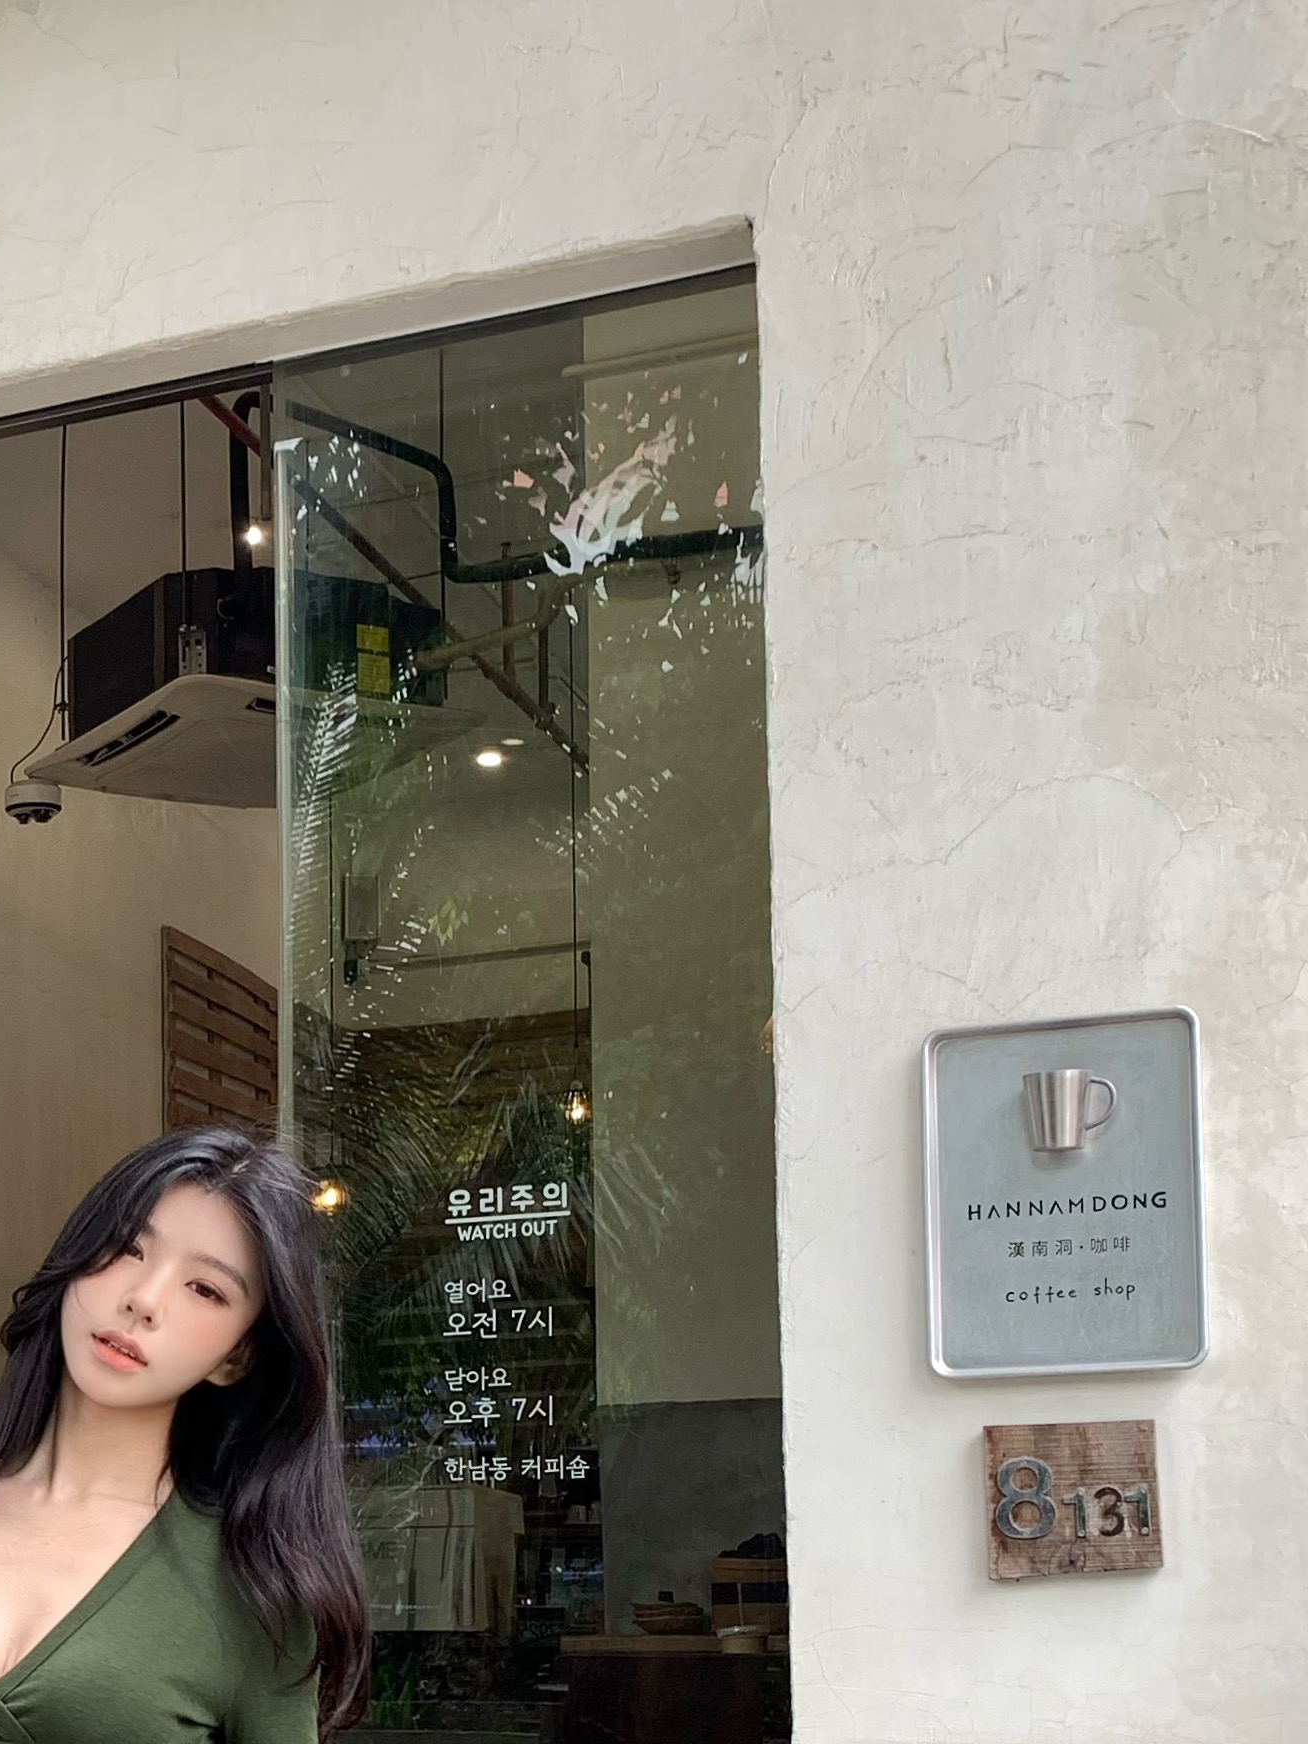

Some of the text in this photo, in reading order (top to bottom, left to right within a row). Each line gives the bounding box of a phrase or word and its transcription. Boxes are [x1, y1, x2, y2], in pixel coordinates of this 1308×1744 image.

[447, 1181, 571, 1217] 유리주의
[967, 1190, 1167, 1221] HANNAMDONG
[457, 1219, 558, 1242] WATCH OUT
[444, 1278, 511, 1304] 열어요
[1005, 1277, 1136, 1304] coffee shop
[443, 1306, 553, 1339] 오전 7시
[444, 1366, 512, 1392] 닫아요
[443, 1395, 553, 1428] 오후 7시
[444, 1454, 590, 1481] 한남동 커피숍
